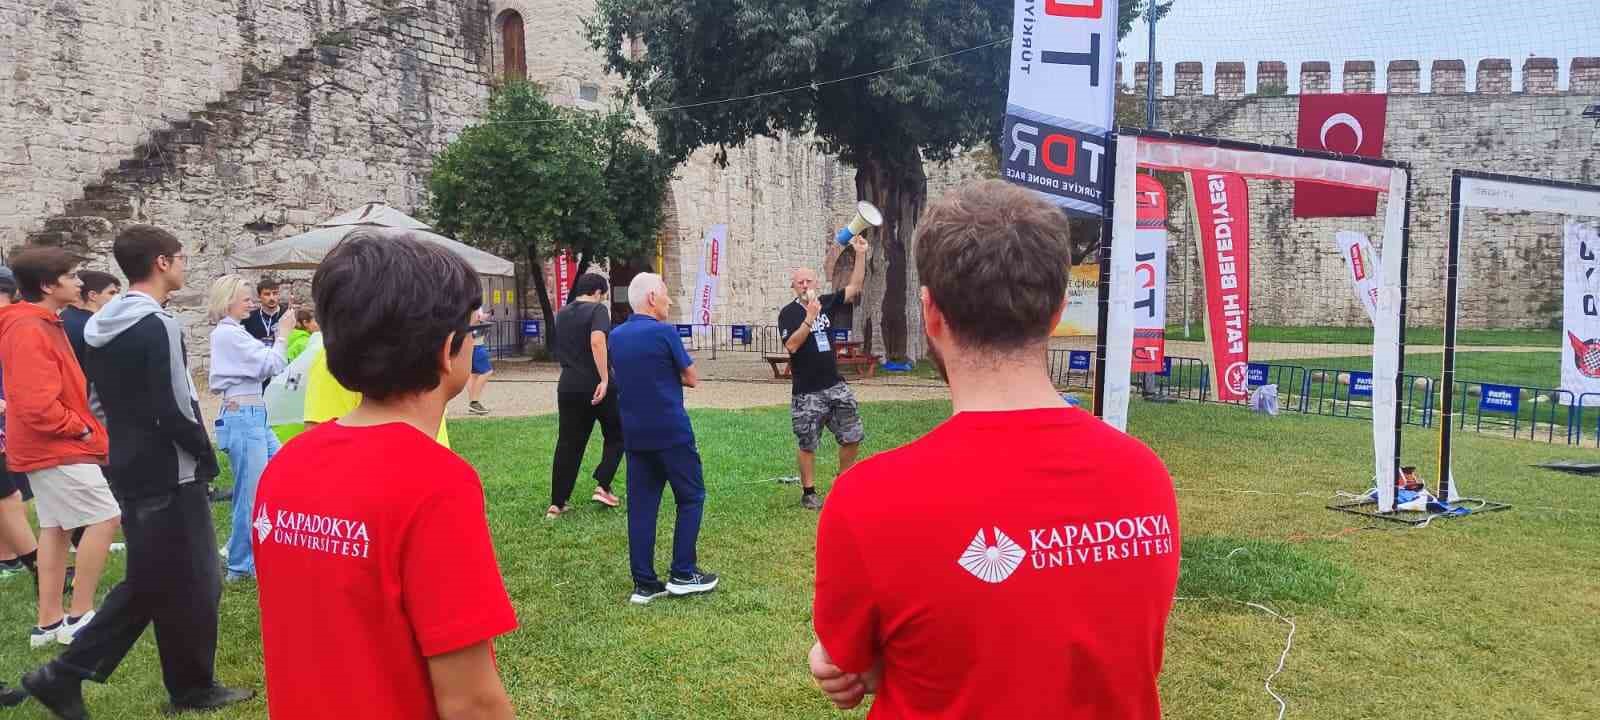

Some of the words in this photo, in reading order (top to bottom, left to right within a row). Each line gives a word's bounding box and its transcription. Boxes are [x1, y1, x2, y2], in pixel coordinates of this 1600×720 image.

[276, 509, 370, 541] KAPADOKYA
[1029, 514, 1171, 551] KAPADOKYA
[274, 527, 369, 558] ÜNİVERSİTESİ
[1031, 535, 1173, 569] ÜNİVERSİTESİ
